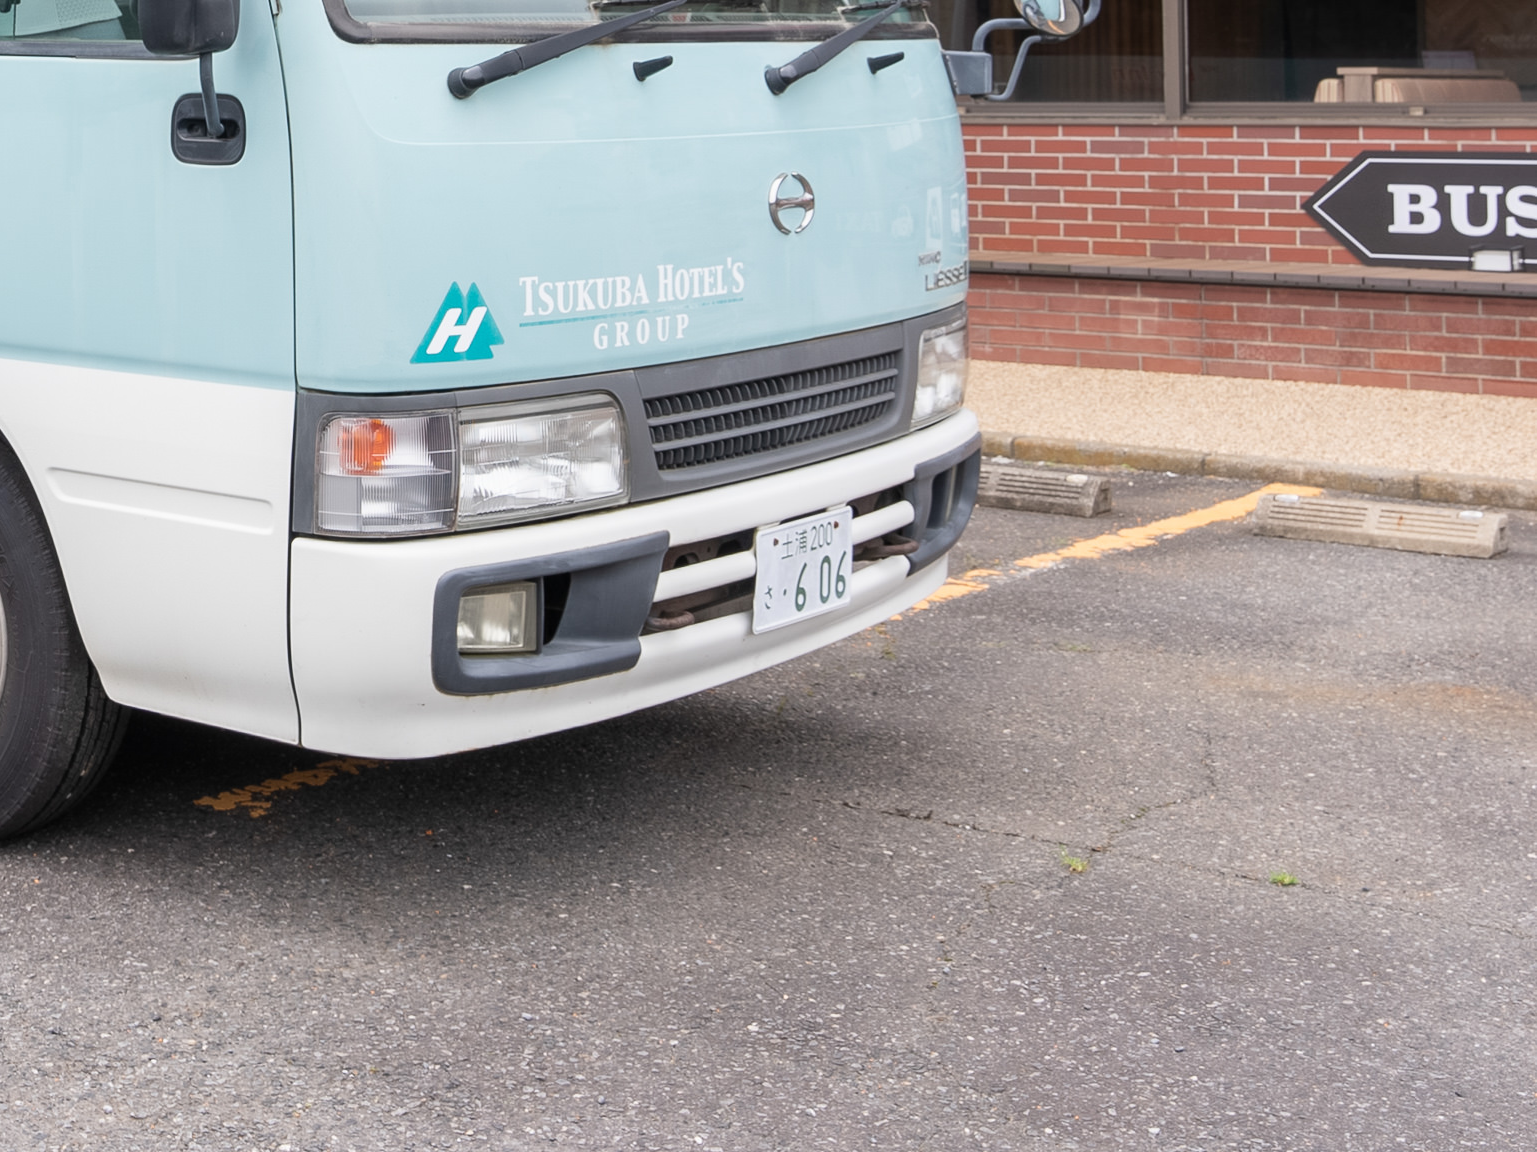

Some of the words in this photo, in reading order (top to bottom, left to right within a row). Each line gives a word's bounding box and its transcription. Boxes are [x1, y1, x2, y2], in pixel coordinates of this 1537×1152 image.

[1386, 183, 1537, 238] BUS
[518, 273, 650, 317] TSUKUBA
[656, 257, 745, 303] HOTEL'S
[426, 306, 488, 355] H
[593, 314, 690, 350] GROUP
